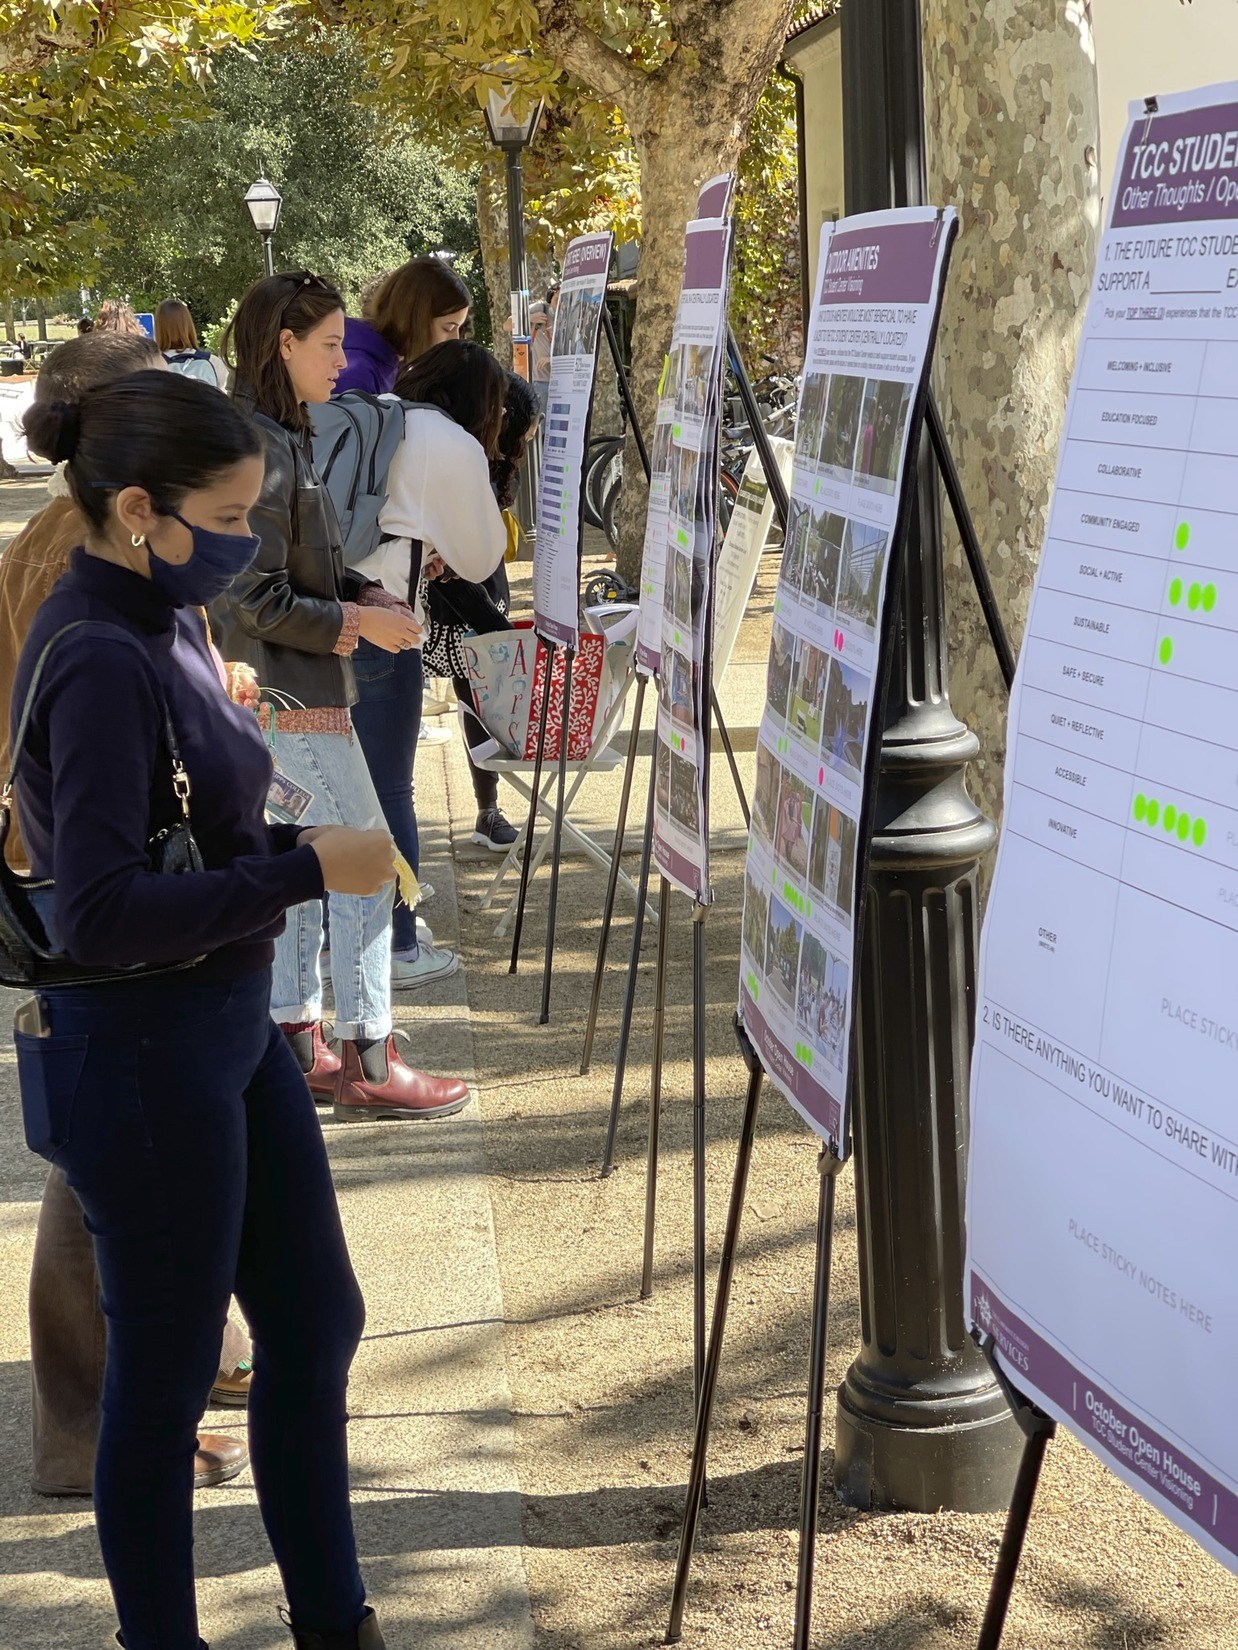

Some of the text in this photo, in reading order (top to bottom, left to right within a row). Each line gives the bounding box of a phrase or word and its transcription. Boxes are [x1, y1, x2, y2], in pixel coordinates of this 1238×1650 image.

[1131, 131, 1238, 180] TCC STUDE
[1121, 186, 1153, 211] Other
[1154, 179, 1206, 211] Thoughts
[1105, 243, 1111, 261] 1.
[1114, 241, 1133, 260] THE
[1132, 238, 1174, 260] FUTURE
[1175, 236, 1199, 258] TCC
[1097, 270, 1144, 292] SUPPORT
[1142, 270, 1151, 290] A
[1139, 307, 1158, 320] THREE
[1107, 361, 1139, 372] WELCOMING
[1142, 362, 1172, 373] INCLUSIVE
[1101, 411, 1158, 426] EDUCATION FOCUSED
[1097, 463, 1142, 478] COLLABORATIVE
[1080, 513, 1140, 532] COMMUNITY ENGAGED
[1079, 564, 1099, 578] SOCIAL
[1103, 569, 1123, 583] ACTIVE
[1073, 616, 1110, 634] SUSTAINABLE
[508, 638, 528, 678] A
[1062, 665, 1077, 679] SAFE
[1081, 671, 1104, 686] SECURE
[1050, 713, 1067, 728] QUIET
[1071, 720, 1104, 740] REFLECTIVE
[1055, 766, 1087, 787] ACCESSIBLE
[1048, 818, 1077, 839] INNOVATIVE
[1038, 927, 1057, 944] OTHER
[1160, 997, 1199, 1031] PLACE
[982, 1005, 990, 1025] 2.
[992, 1010, 1002, 1032] IS
[1003, 1016, 1035, 1052] THERE
[1035, 1037, 1086, 1083] ANYTHING
[1088, 1067, 1111, 1098] YOU
[1112, 1082, 1146, 1120] WANT
[1147, 1103, 1163, 1131] TO
[1165, 1116, 1209, 1159] SHARE
[1068, 1218, 1213, 1334] PLACE STICKY NOTES HERE
[1085, 1390, 1202, 1497] October Open House
[1091, 1415, 1194, 1511] TCC Student Center Visioning
